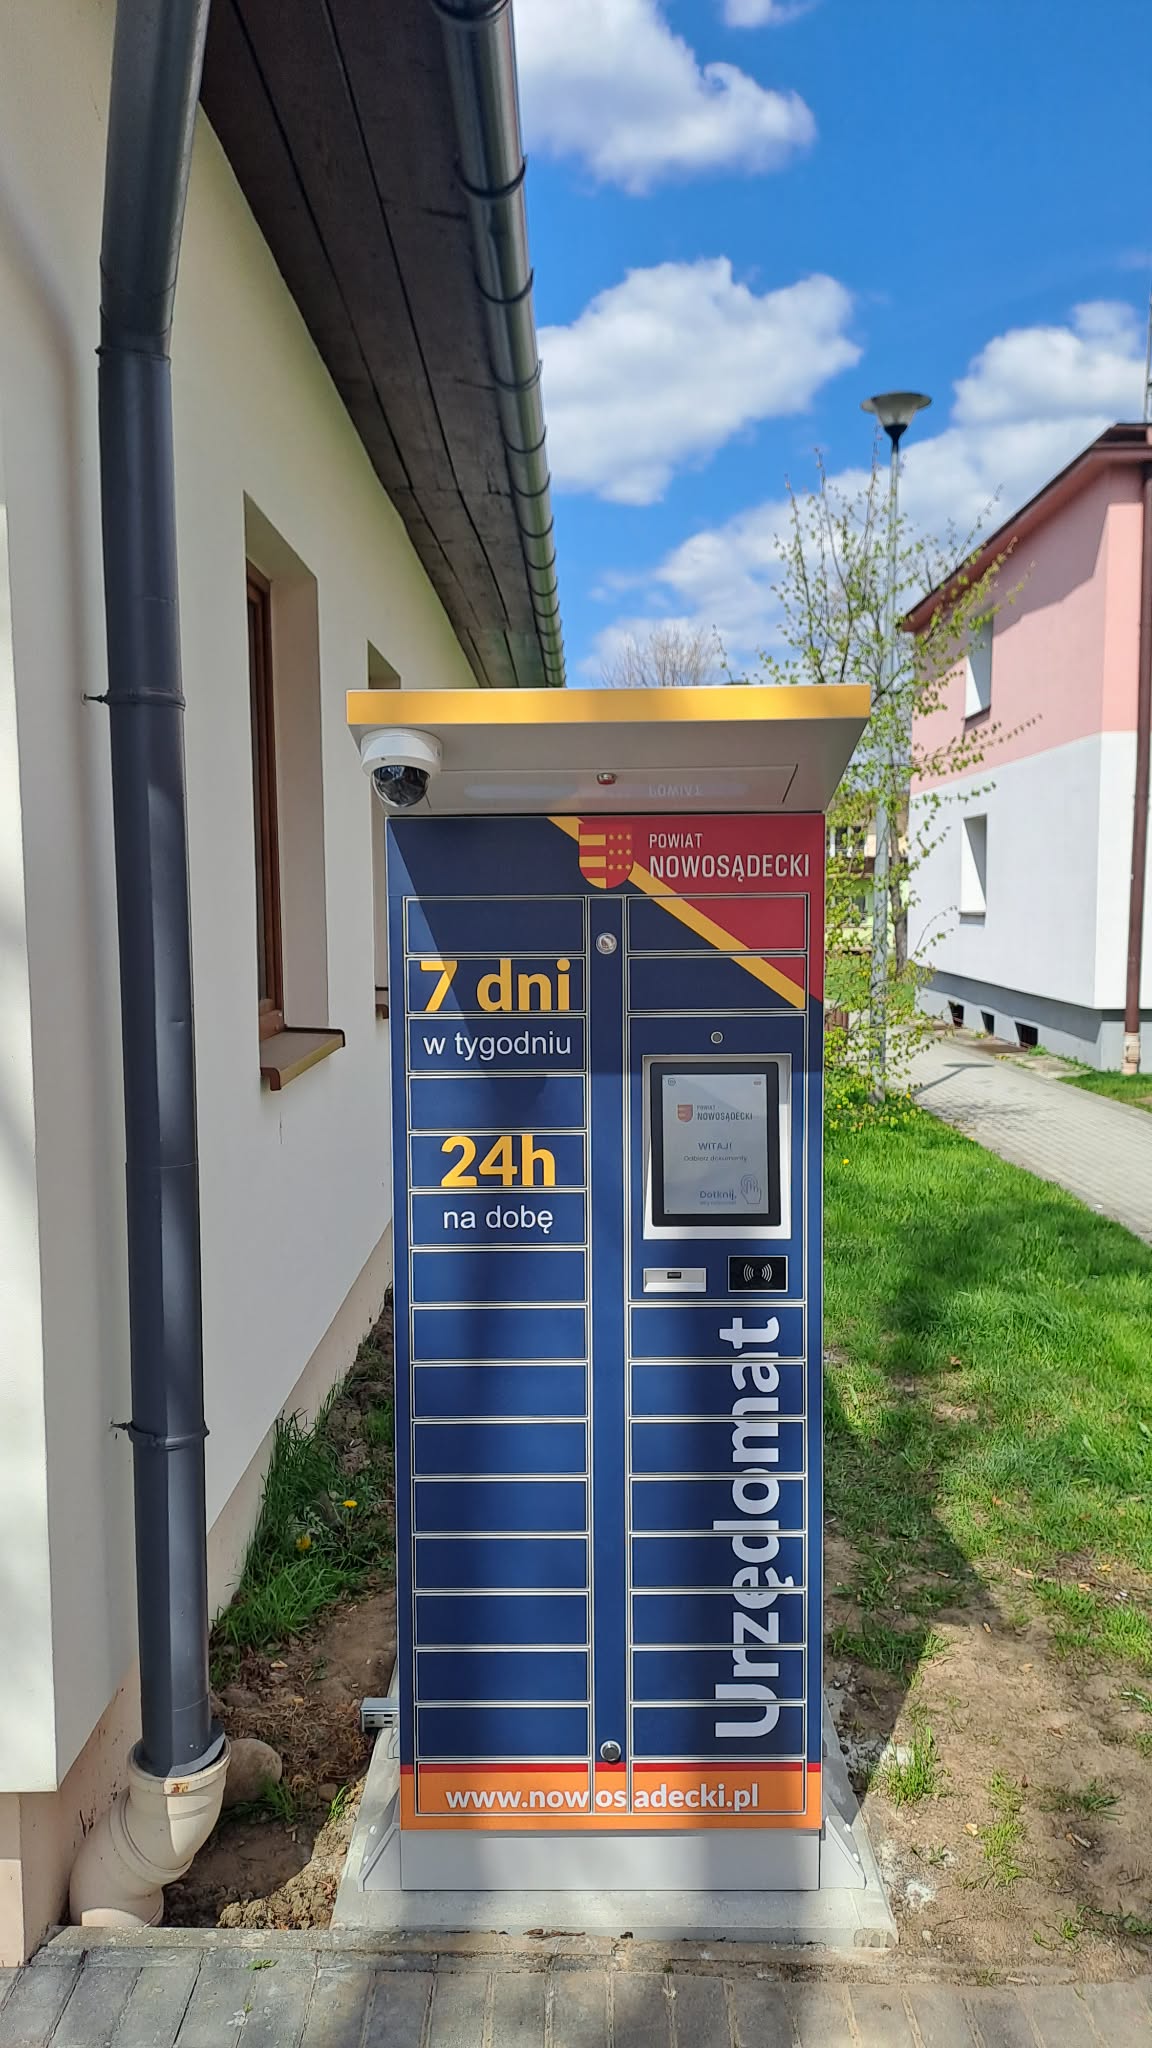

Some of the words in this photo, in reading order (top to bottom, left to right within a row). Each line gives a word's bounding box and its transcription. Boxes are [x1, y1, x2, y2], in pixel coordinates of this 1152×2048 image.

[649, 833, 703, 849] POWIAT
[650, 854, 809, 882] NOWOSĄDECKI
[420, 960, 458, 1012] 7
[476, 958, 571, 1012] dni
[423, 1036, 446, 1055] w
[454, 1031, 571, 1061] tygodniu
[697, 1112, 753, 1122] NOWOSĄDECKI
[440, 1134, 556, 1187] 24h
[698, 1142, 732, 1151] WITAJ!
[443, 1210, 475, 1229] na
[485, 1205, 553, 1233] dobę
[713, 1316, 795, 1738] Urzędomat
[446, 1783, 758, 1811] www.nowosadecki.pl
